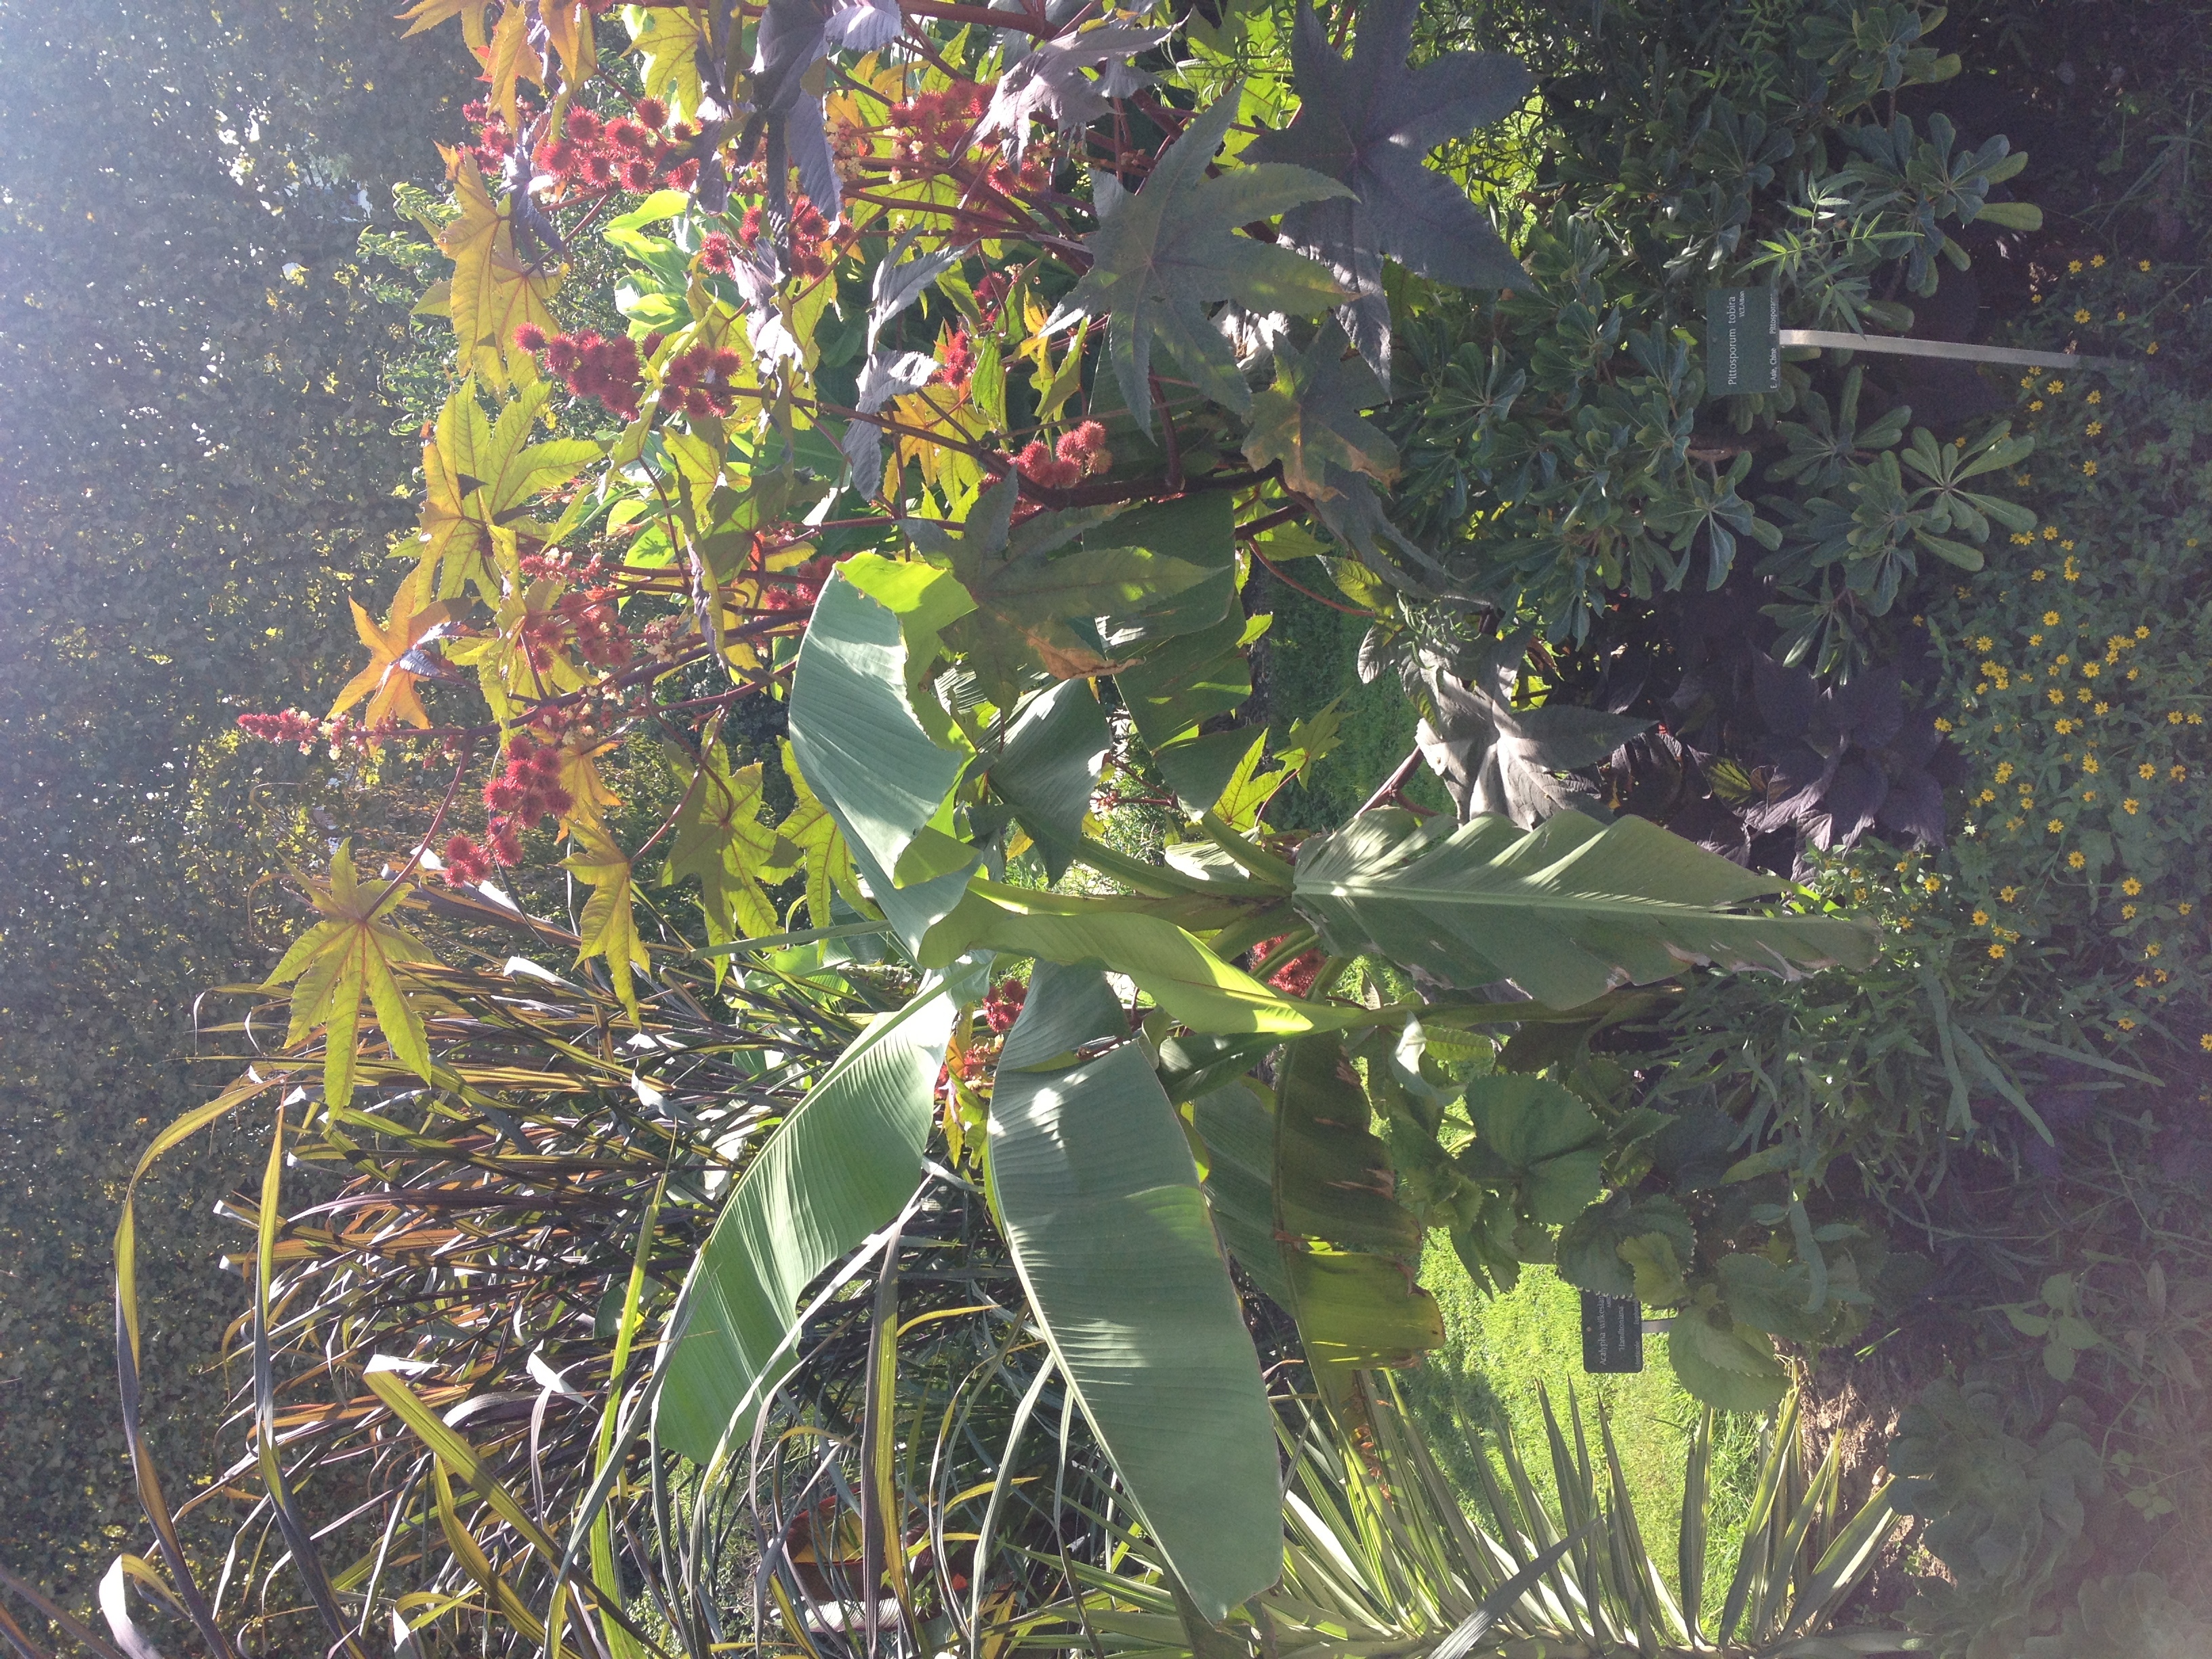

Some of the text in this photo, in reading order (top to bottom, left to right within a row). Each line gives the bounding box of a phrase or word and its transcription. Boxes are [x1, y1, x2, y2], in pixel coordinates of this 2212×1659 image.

[1727, 296, 1740, 385] Pittosporum tobira
[1597, 1295, 1608, 1366] Acalypha wilkesian
